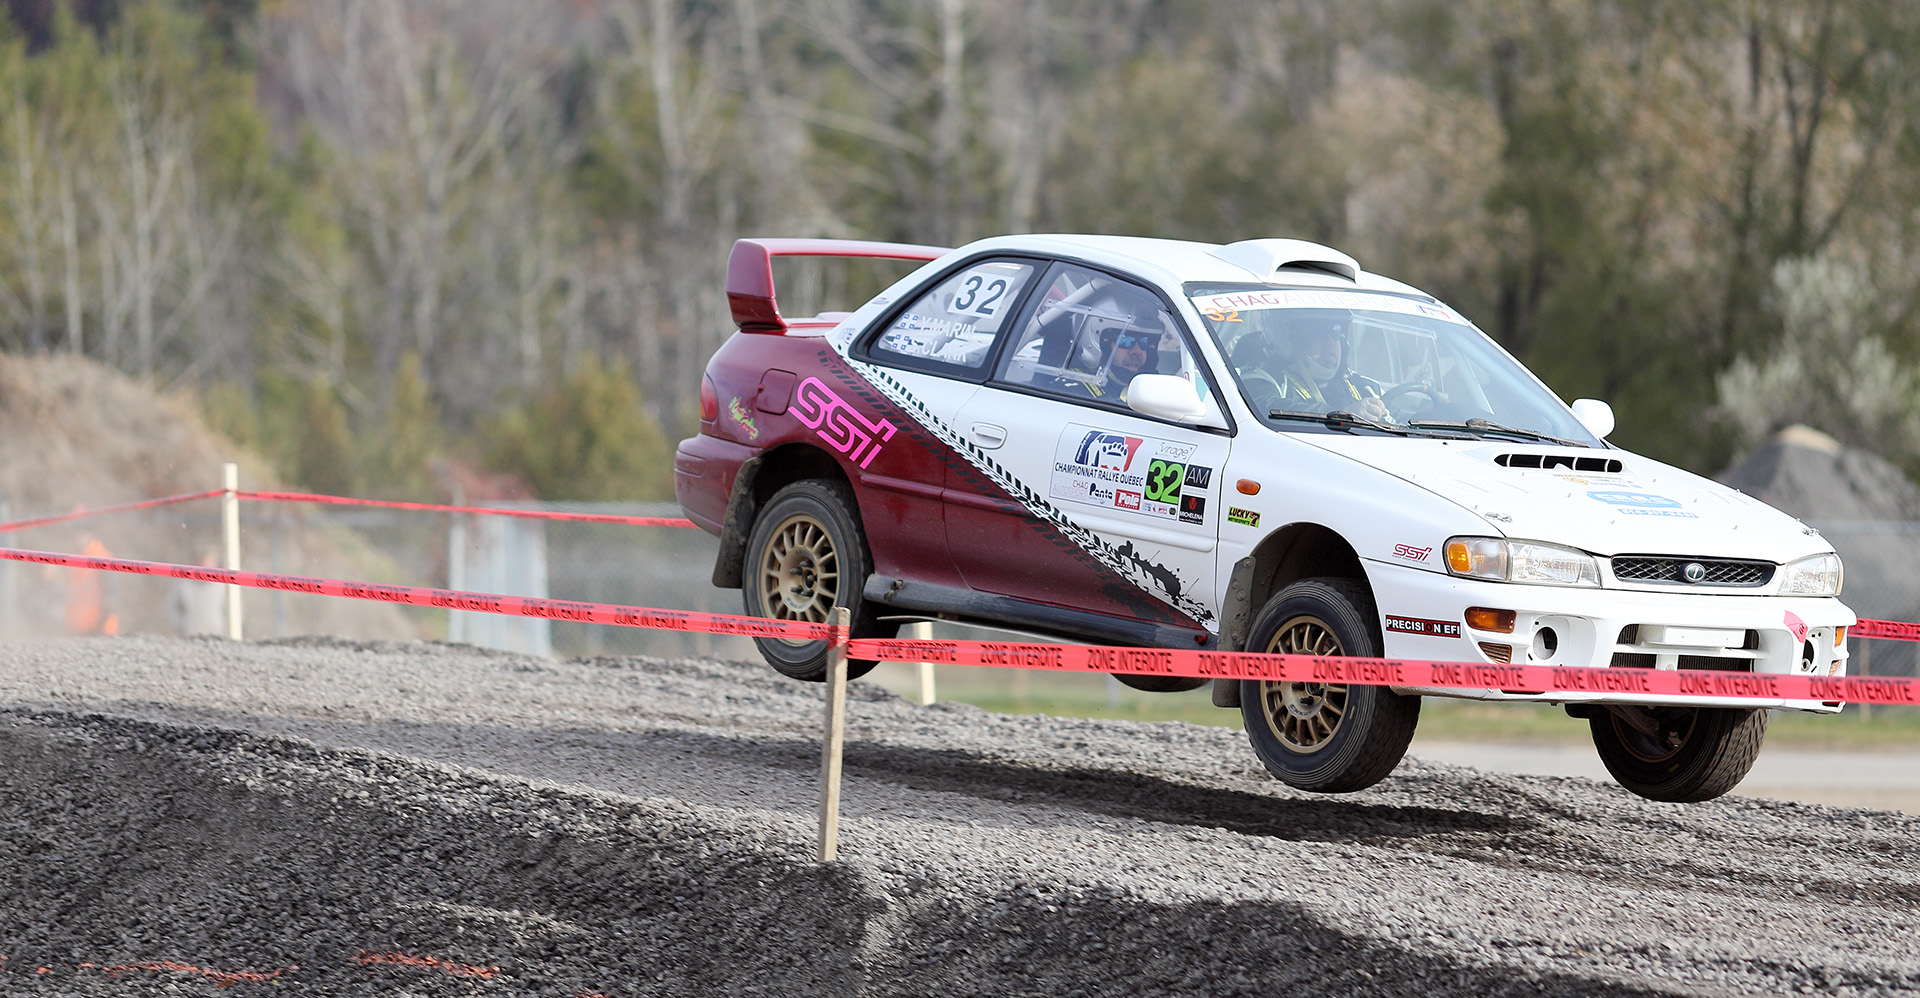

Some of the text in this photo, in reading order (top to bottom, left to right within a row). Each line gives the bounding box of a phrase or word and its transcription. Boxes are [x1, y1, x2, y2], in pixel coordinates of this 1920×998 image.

[954, 275, 1007, 315] 32
[1212, 293, 1280, 309] CHAG
[1283, 292, 1412, 312] AUTOSPORT
[1204, 308, 1244, 323] 32
[1054, 462, 1098, 478] CHAMPIONNAT
[1098, 469, 1120, 483] RALLYE
[1145, 460, 1184, 505] 32
[1186, 467, 1210, 485] AM
[1072, 480, 1088, 490] CHAG
[1229, 507, 1260, 527] LUCKY 7
[1386, 618, 1460, 635] PRECISION EFI
[980, 644, 1063, 667] ZONE INTERDITE
[1087, 648, 1172, 673] ZONE INTERDITE
[1198, 654, 1286, 678] ZONE INTERDITE
[1312, 659, 1403, 682] ZONE INTERDITE
[1431, 663, 1525, 687] ZONE INTERDITE
[1552, 668, 1649, 692] ZONE INTERDITE
[1678, 672, 1779, 697] ZONE INTERDITE
[1809, 677, 1913, 701] ZONE INTERDITE
